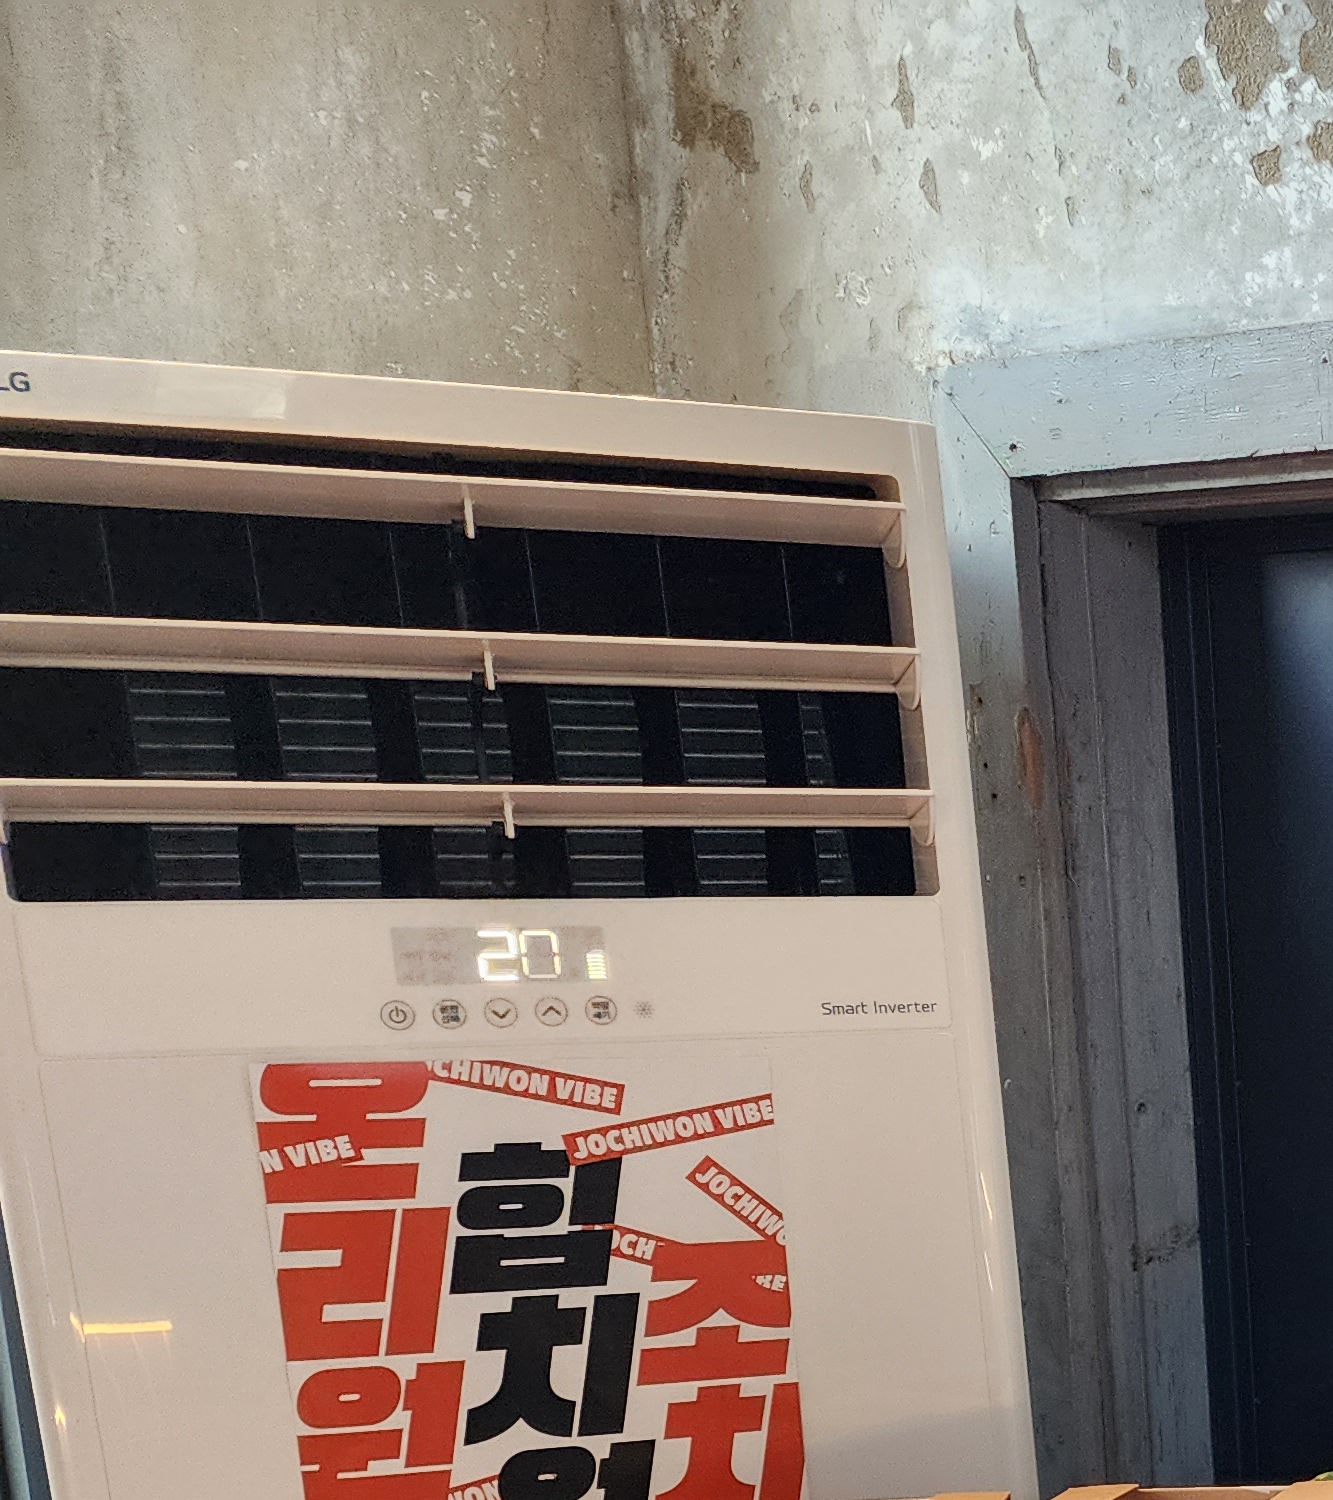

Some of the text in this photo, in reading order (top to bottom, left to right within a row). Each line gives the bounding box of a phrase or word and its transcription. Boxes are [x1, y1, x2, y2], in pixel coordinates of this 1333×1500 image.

[475, 928, 562, 982] 20
[821, 1001, 938, 1016] Smart Inverter
[427, 1060, 618, 1110] CHIWON VIBE
[284, 1134, 356, 1169] VIBE
[573, 1098, 775, 1160] JOCHIWON VIBE
[695, 1166, 788, 1247] JOCHIWO
